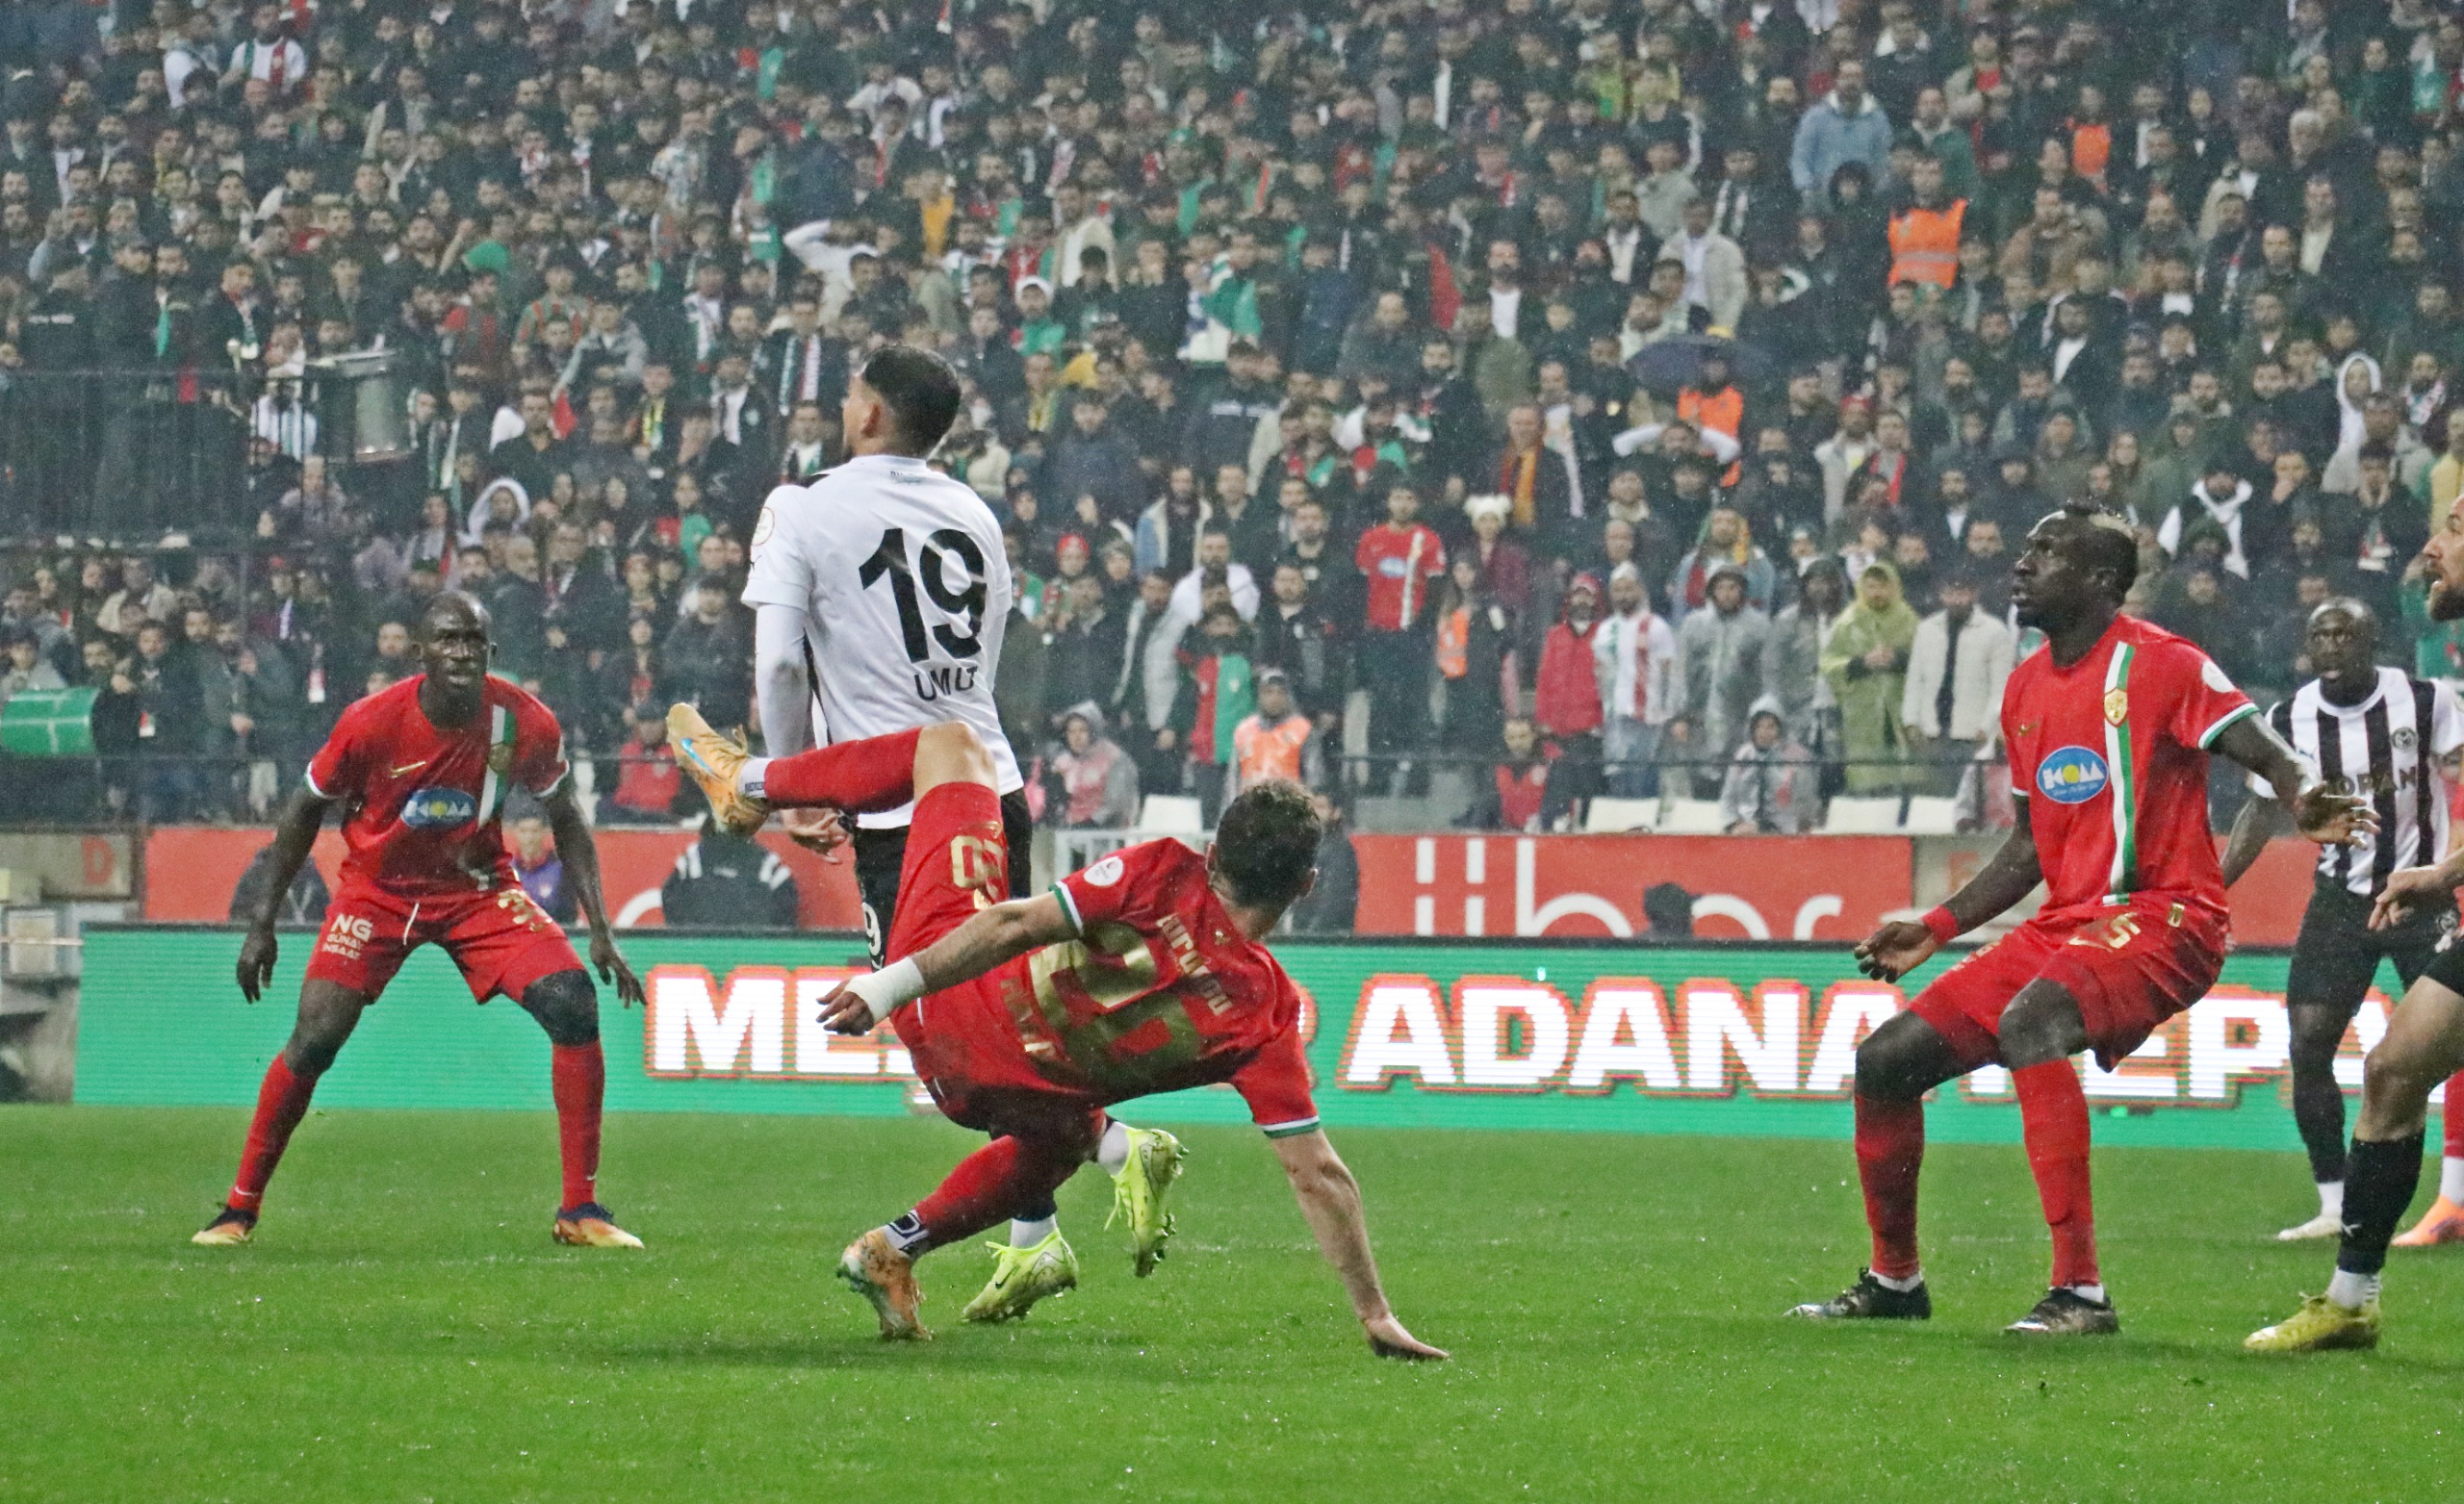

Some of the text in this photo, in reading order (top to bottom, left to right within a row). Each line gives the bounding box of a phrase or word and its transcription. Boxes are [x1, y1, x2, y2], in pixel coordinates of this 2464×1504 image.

[859, 527, 988, 663] 19
[2042, 760, 2106, 790] KOM
[330, 913, 373, 942] NG
